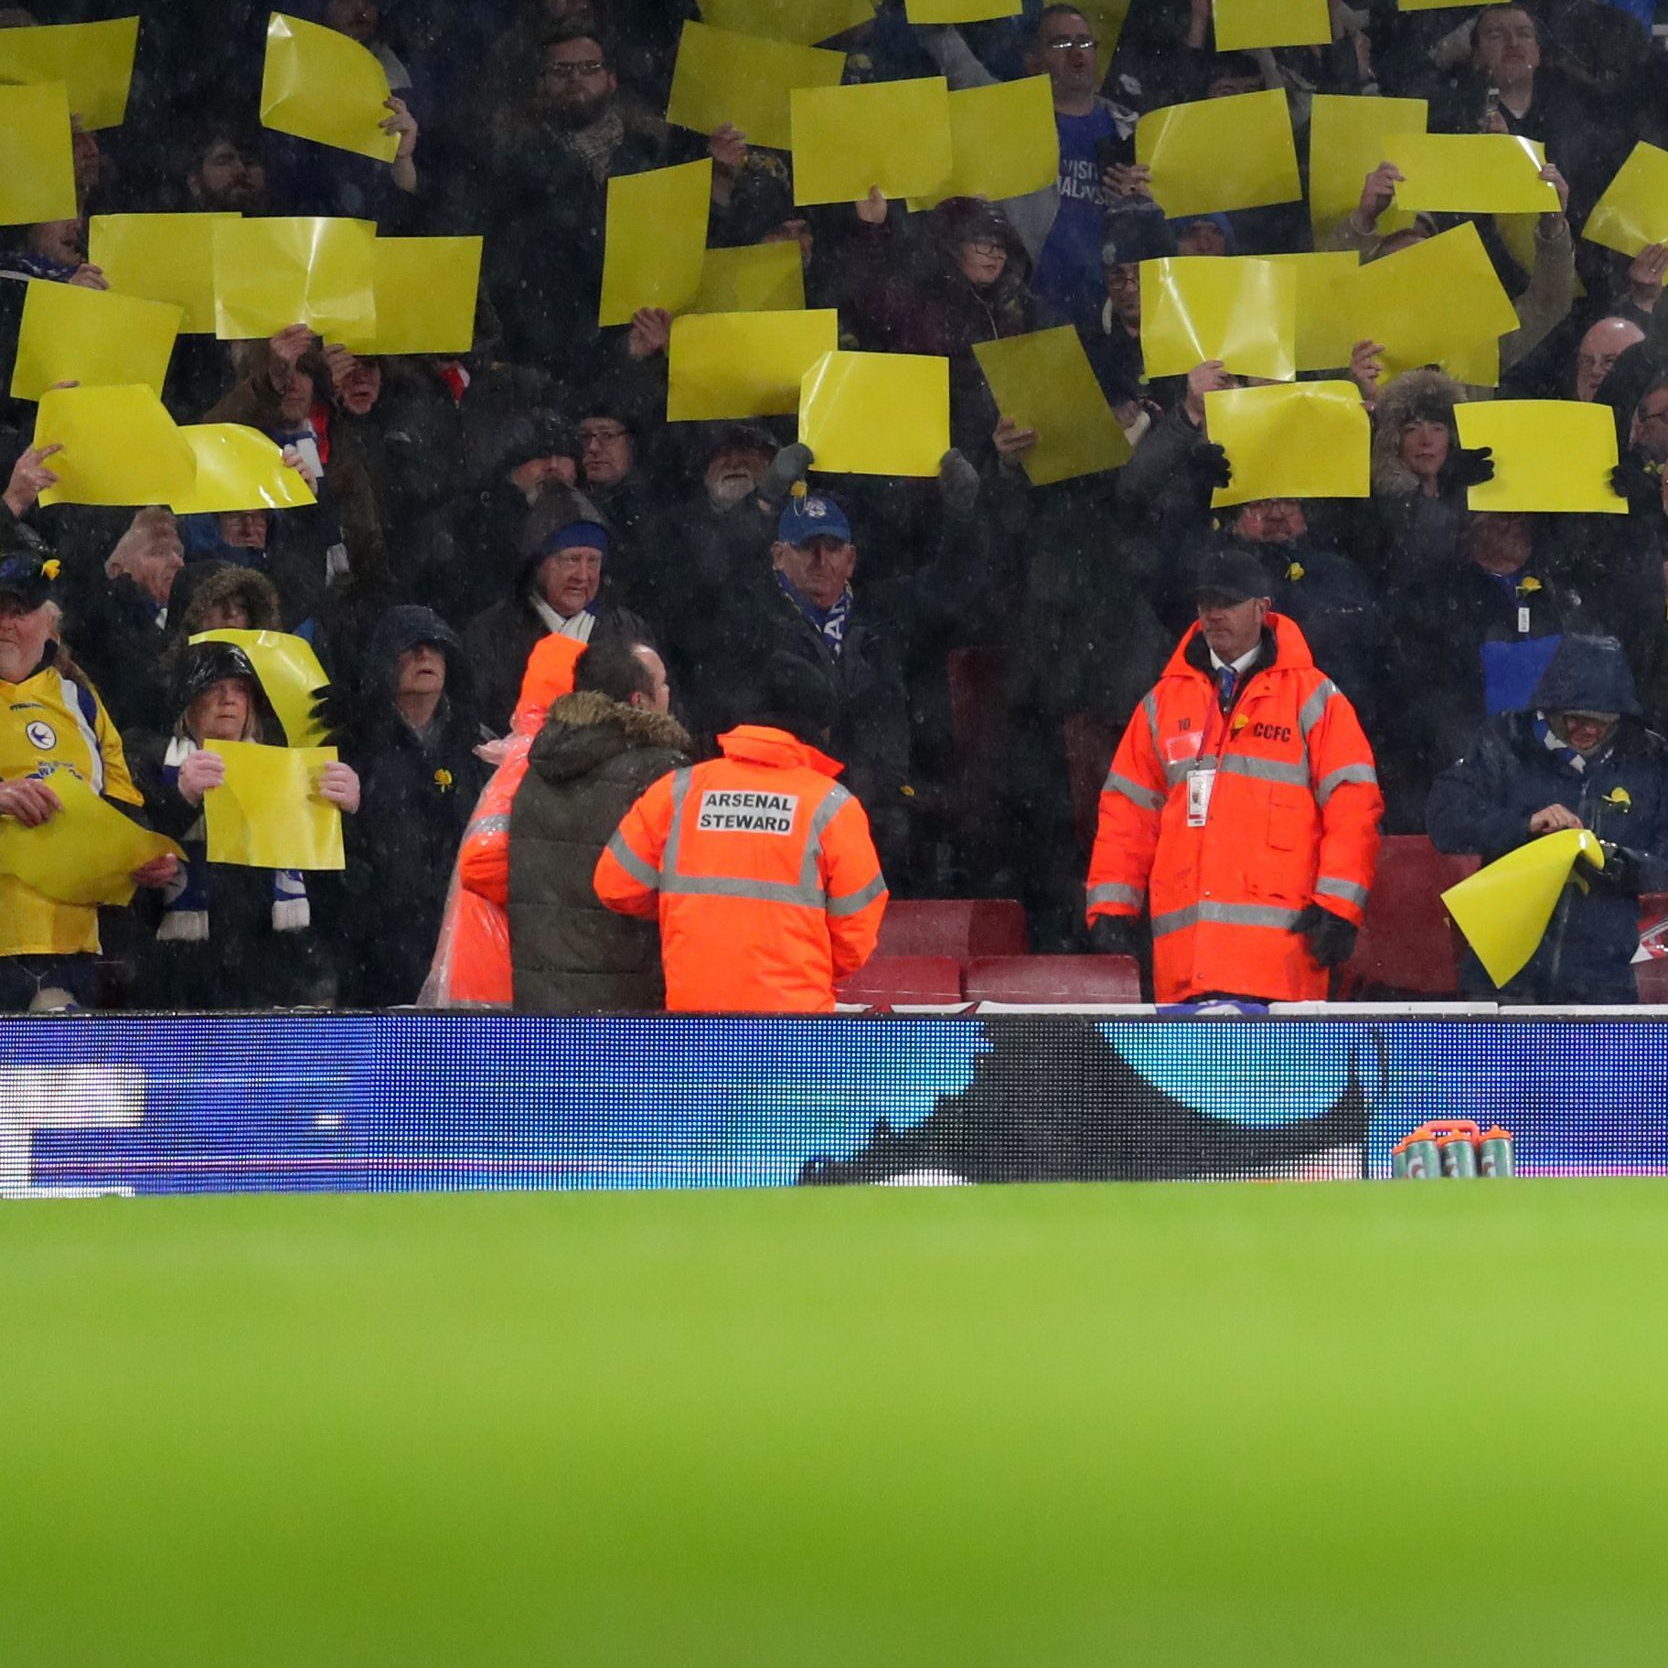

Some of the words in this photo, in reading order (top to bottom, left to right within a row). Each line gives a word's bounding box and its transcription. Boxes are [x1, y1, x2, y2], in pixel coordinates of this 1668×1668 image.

[1253, 721, 1292, 743] CCFC
[705, 792, 793, 812] ARSENAL
[699, 813, 791, 832] STEWARD
